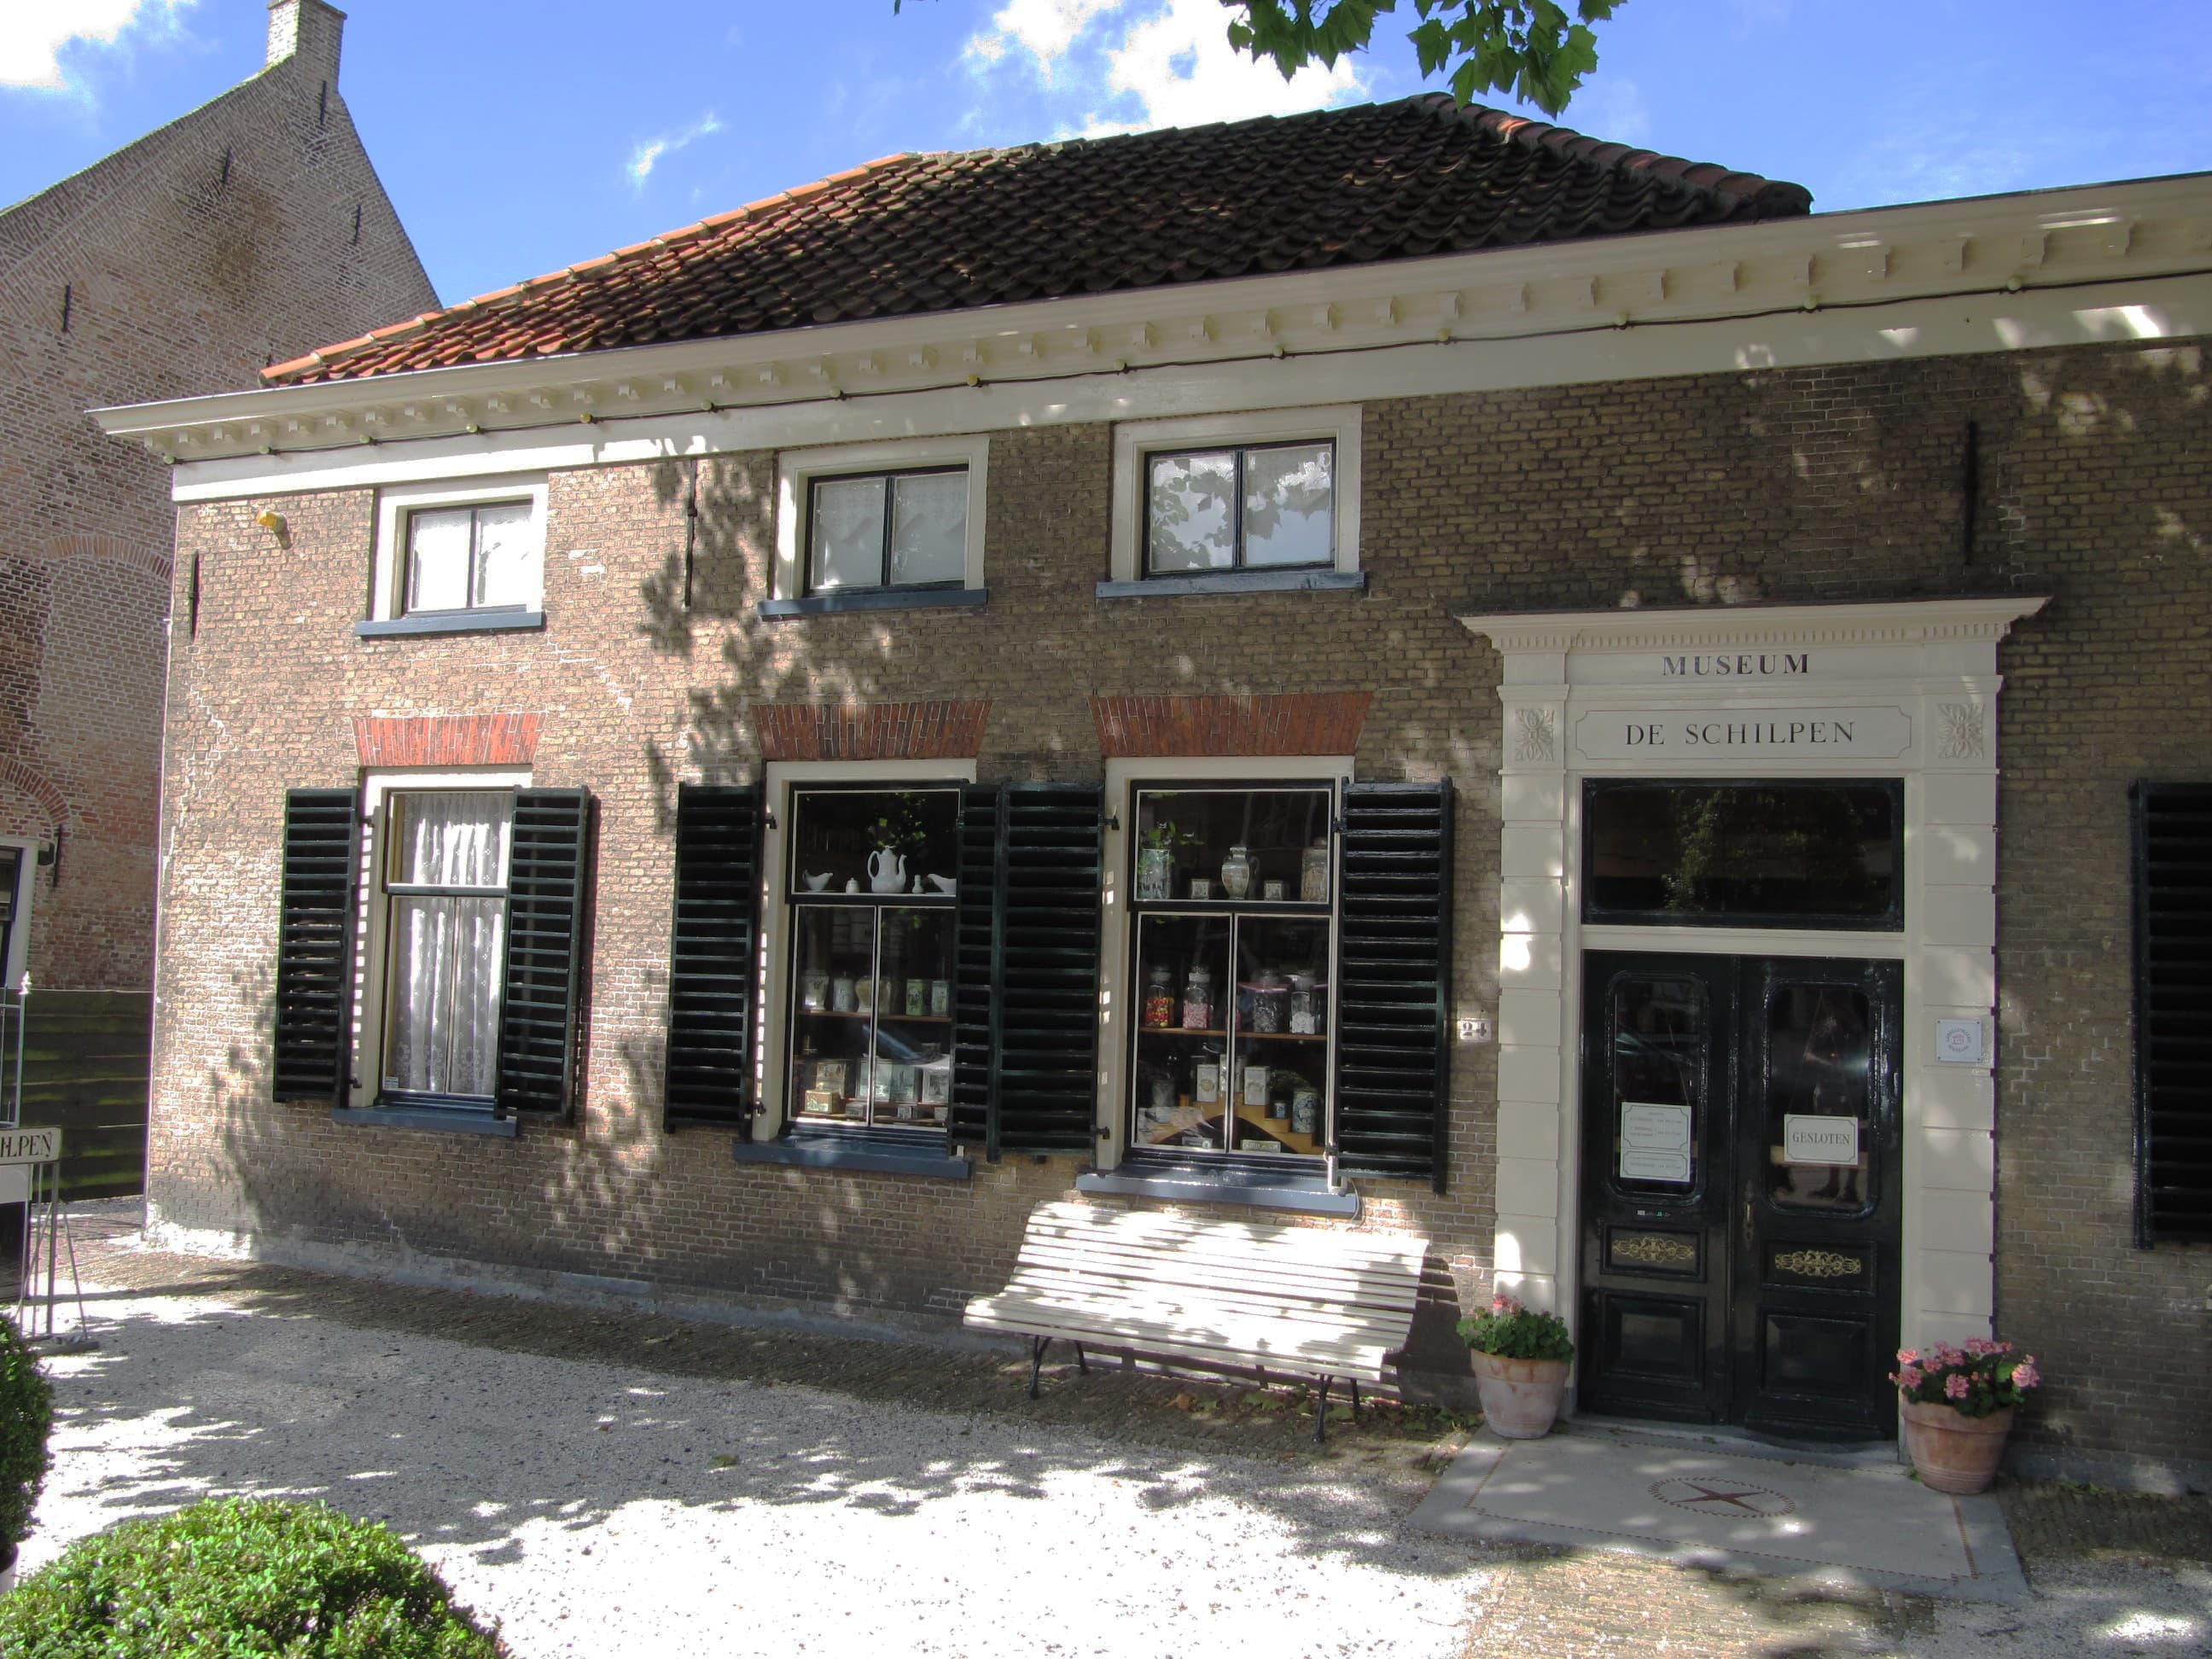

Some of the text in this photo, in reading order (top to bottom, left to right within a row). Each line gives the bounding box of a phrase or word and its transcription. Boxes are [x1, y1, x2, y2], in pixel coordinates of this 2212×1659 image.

[1662, 654, 1809, 676] MUSEUM
[1625, 720, 1856, 746] DE SCHILPEN
[1792, 1132, 1851, 1145] GESLOTEN
